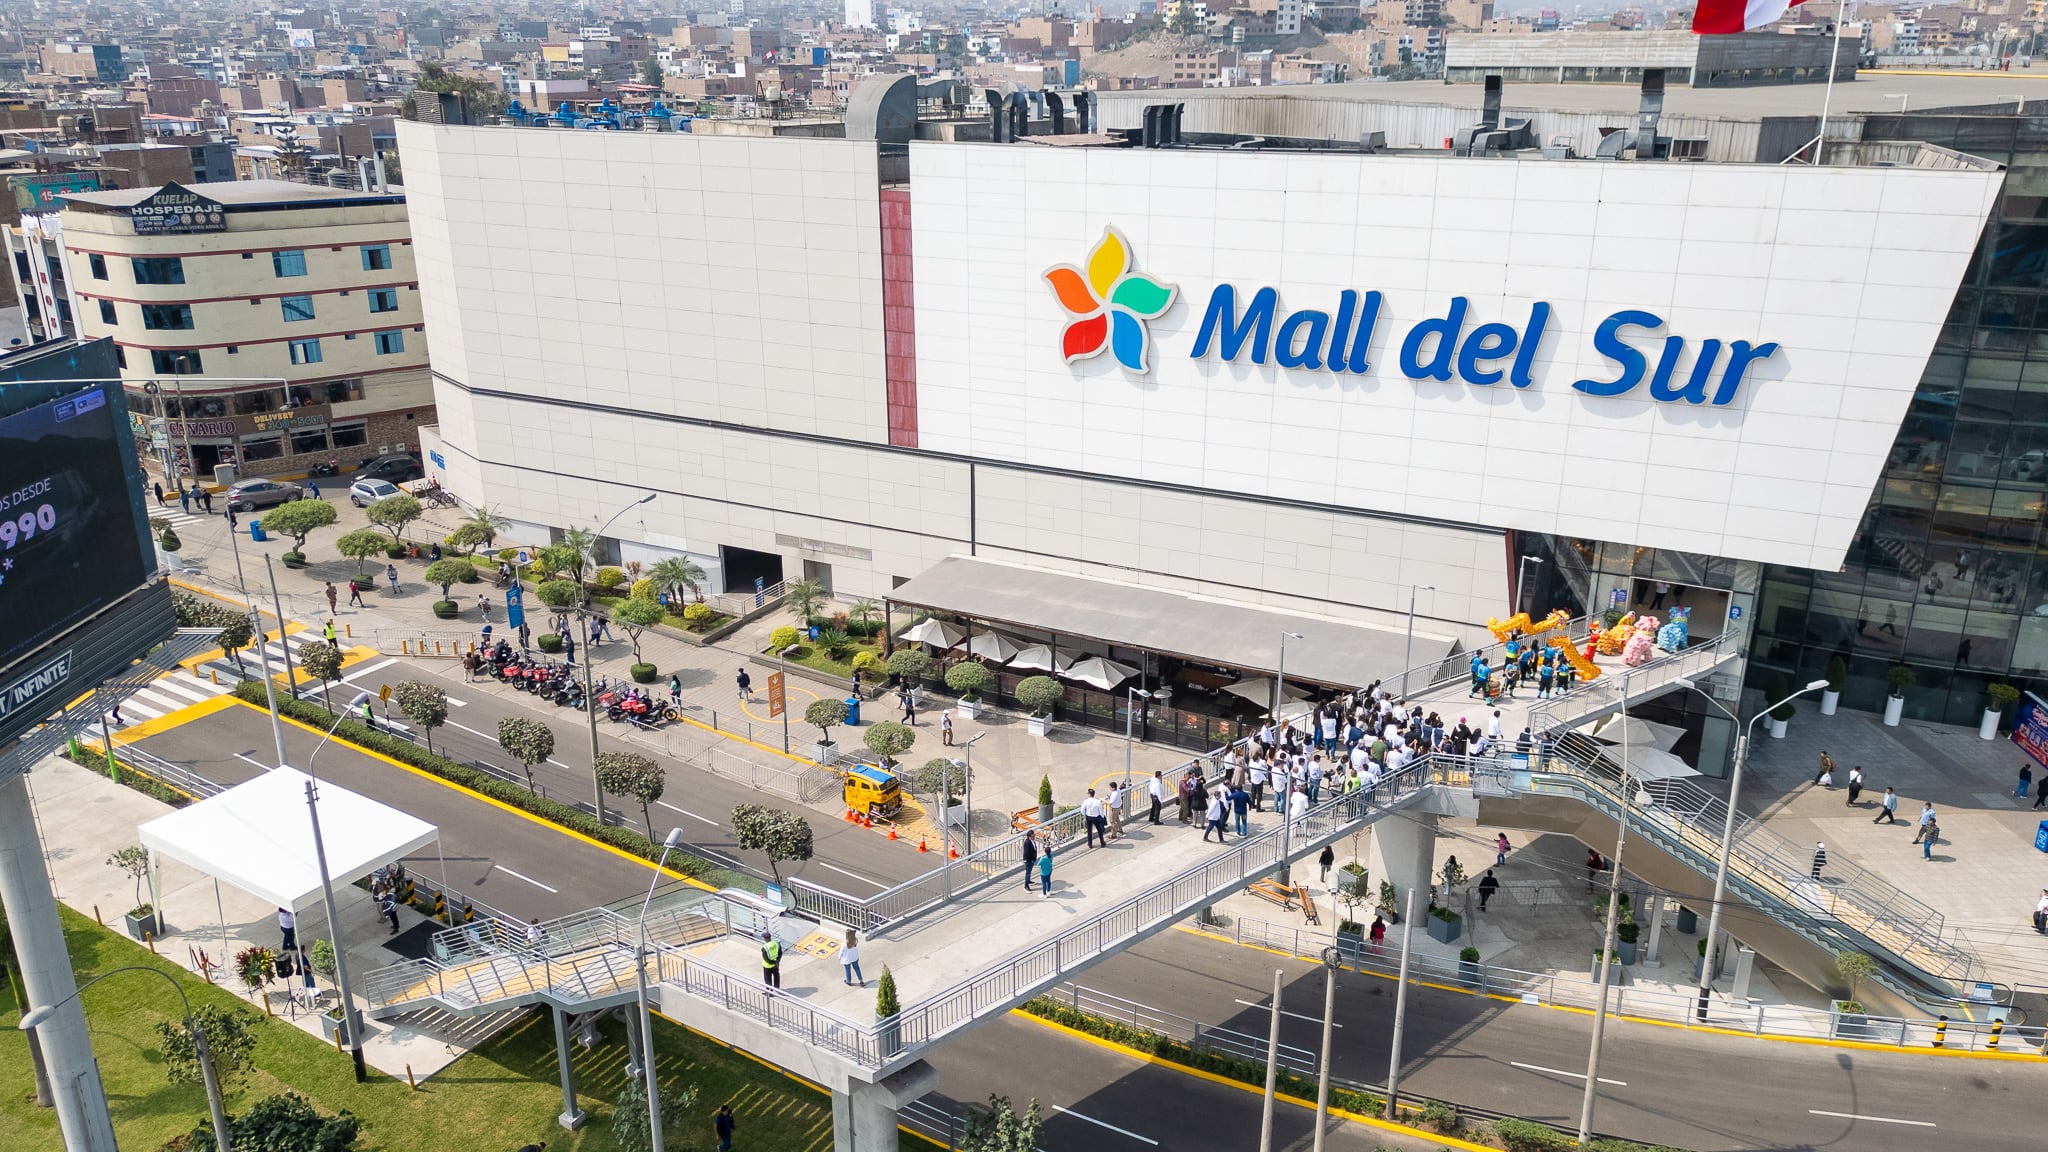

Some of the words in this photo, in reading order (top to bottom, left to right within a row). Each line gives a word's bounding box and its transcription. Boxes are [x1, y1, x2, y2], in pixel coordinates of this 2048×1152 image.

[153, 194, 198, 205] KUELAP
[131, 204, 223, 216] HOSPEDAJE
[1190, 283, 1382, 374] Mall
[1400, 296, 1551, 389] del
[1571, 310, 1779, 406] Sur
[253, 411, 294, 424] DELIVERY
[169, 420, 236, 436] CANARIO
[12, 477, 51, 505] DESDE
[14, 659, 67, 703] INFINITE
